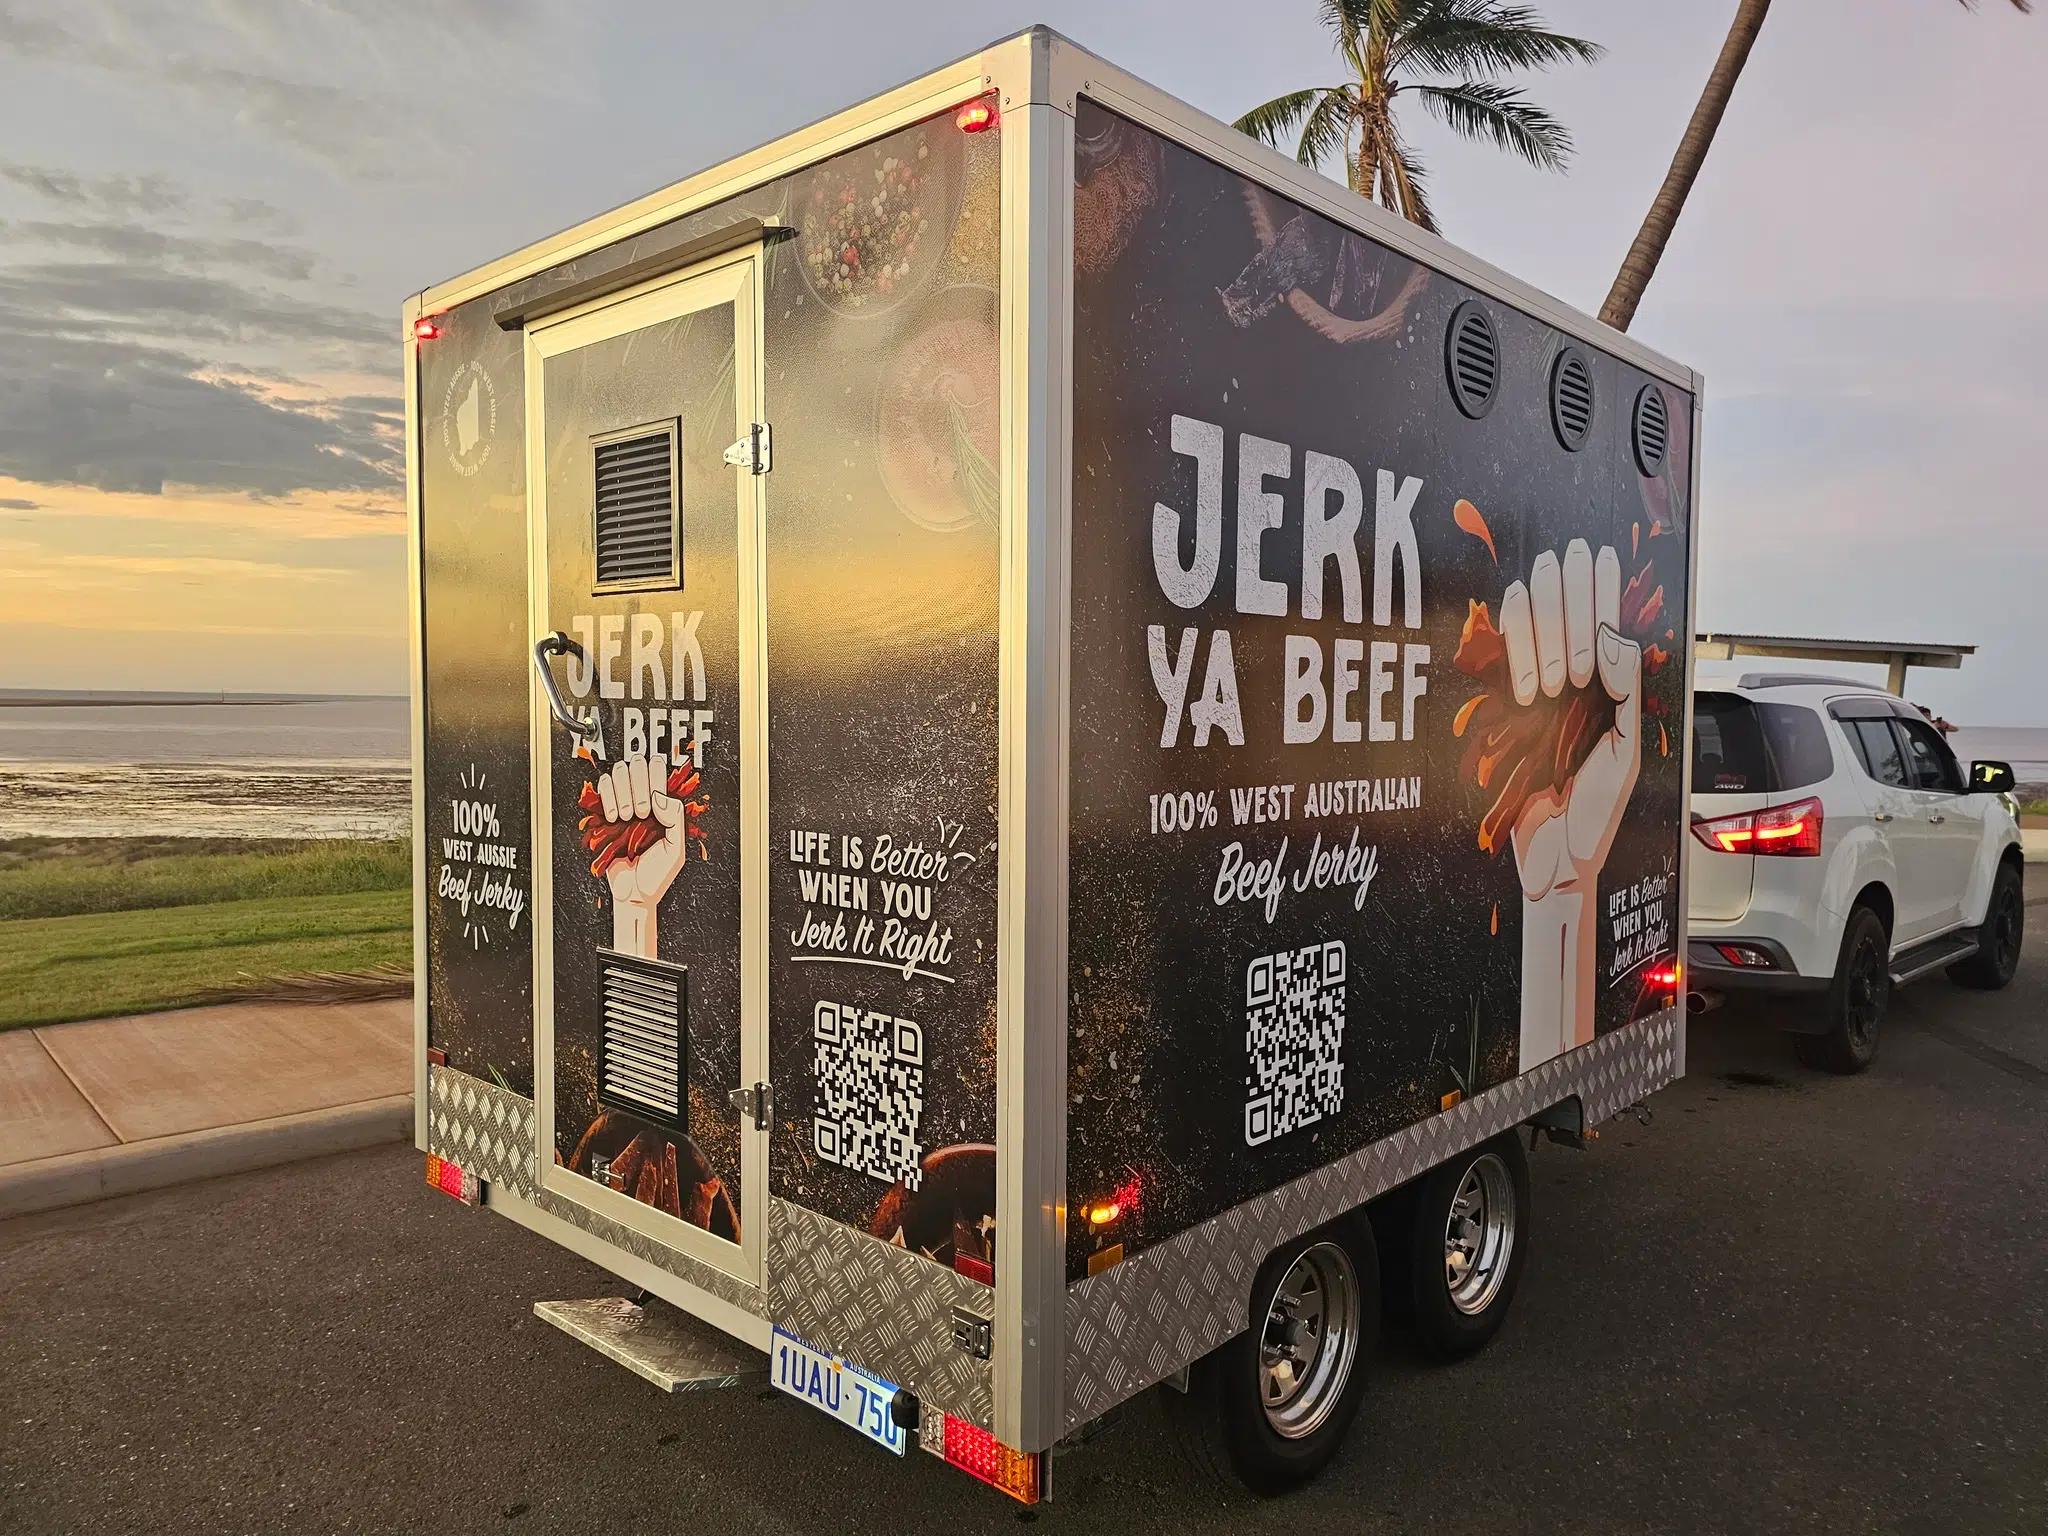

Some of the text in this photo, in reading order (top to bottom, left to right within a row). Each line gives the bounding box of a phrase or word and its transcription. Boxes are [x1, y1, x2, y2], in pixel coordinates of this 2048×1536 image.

[1152, 413, 1424, 629] JERK
[566, 610, 707, 702] JERK
[1147, 624, 1431, 748] YA BEEF
[623, 706, 714, 769] BEEF
[451, 800, 500, 838] 100%
[1149, 776, 1421, 834] 100% WEST AUSTRALIAN
[442, 837, 517, 870] WEST AUSSIE
[790, 829, 949, 882] LIFE IS Better
[1213, 825, 1379, 924] Beef Jerky
[438, 864, 524, 931] Beef Jerky
[799, 869, 931, 921] WHEN YOU
[1609, 874, 1668, 918] LIFE IS Better
[1613, 900, 1662, 942] WHEN YOU
[791, 909, 953, 981] Jerk It Right
[1609, 919, 1669, 977] Jerk It Right
